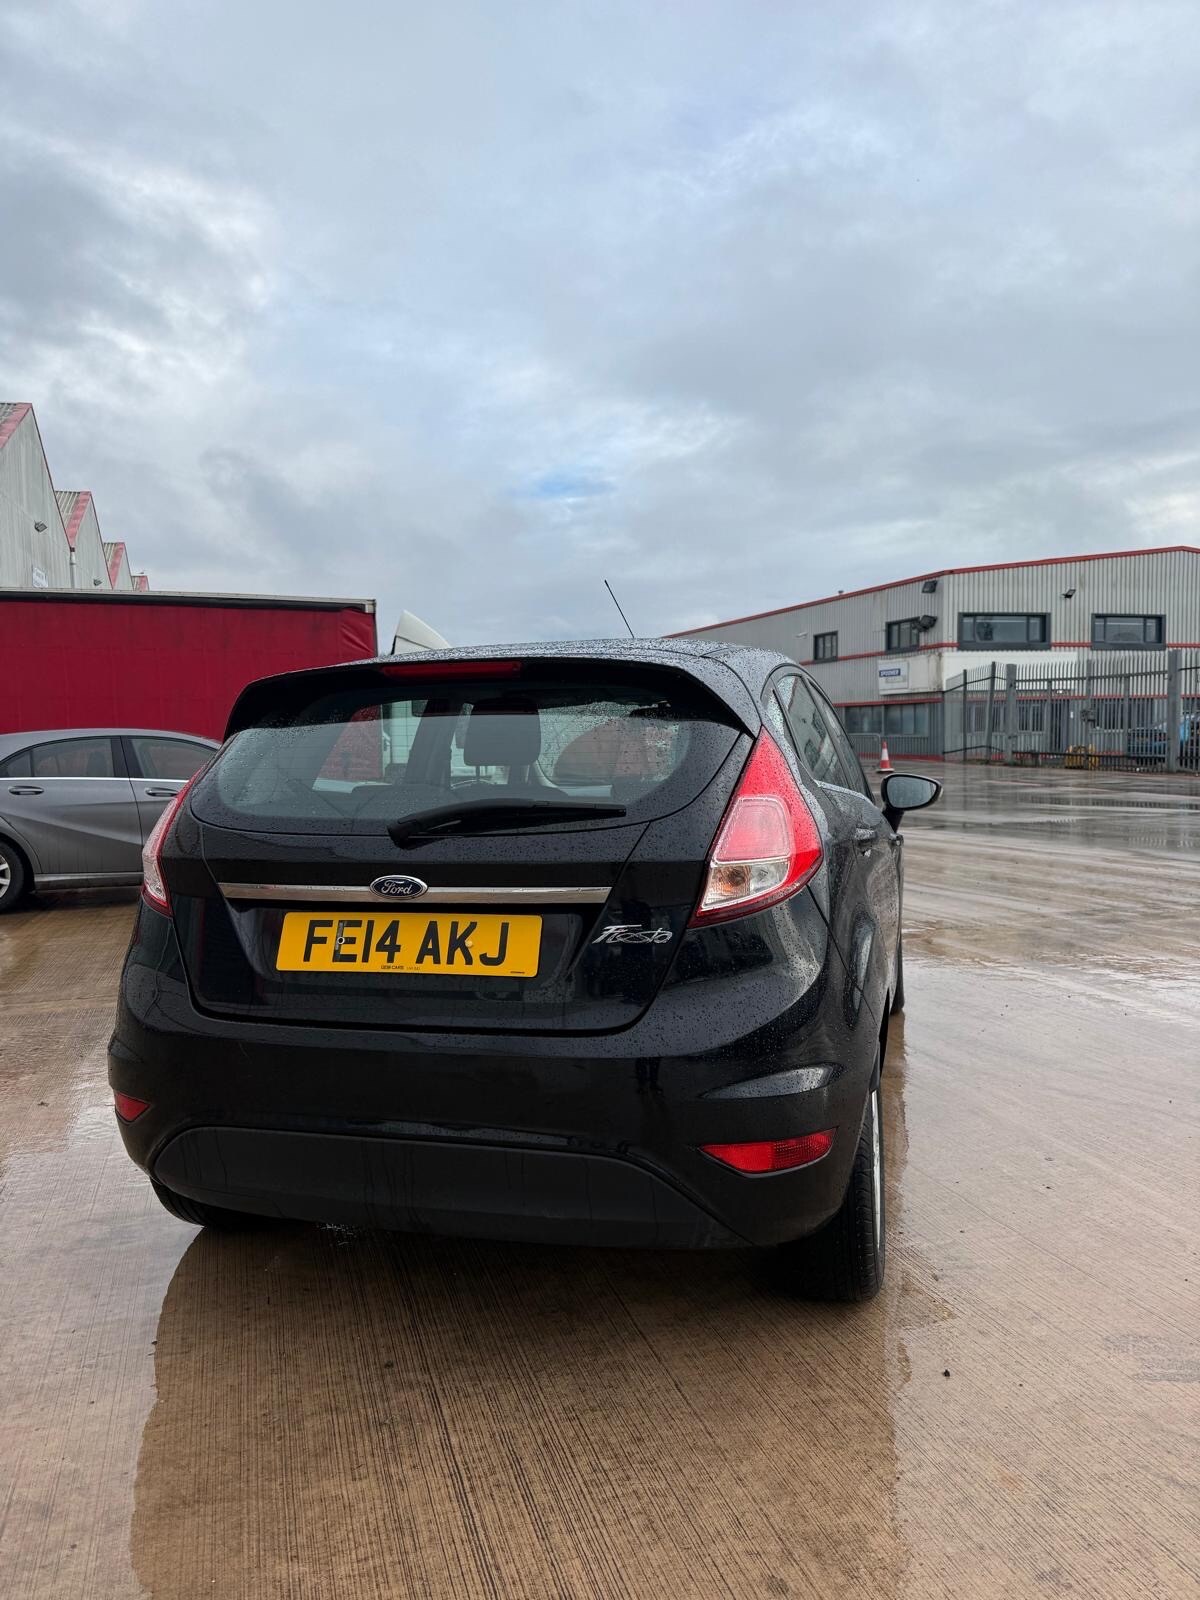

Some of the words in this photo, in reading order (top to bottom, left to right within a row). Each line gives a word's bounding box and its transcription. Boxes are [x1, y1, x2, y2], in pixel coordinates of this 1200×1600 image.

[381, 880, 413, 894] Ford
[302, 919, 401, 964] FE14
[415, 920, 510, 967] AKJ
[591, 924, 673, 944] Fiesta
